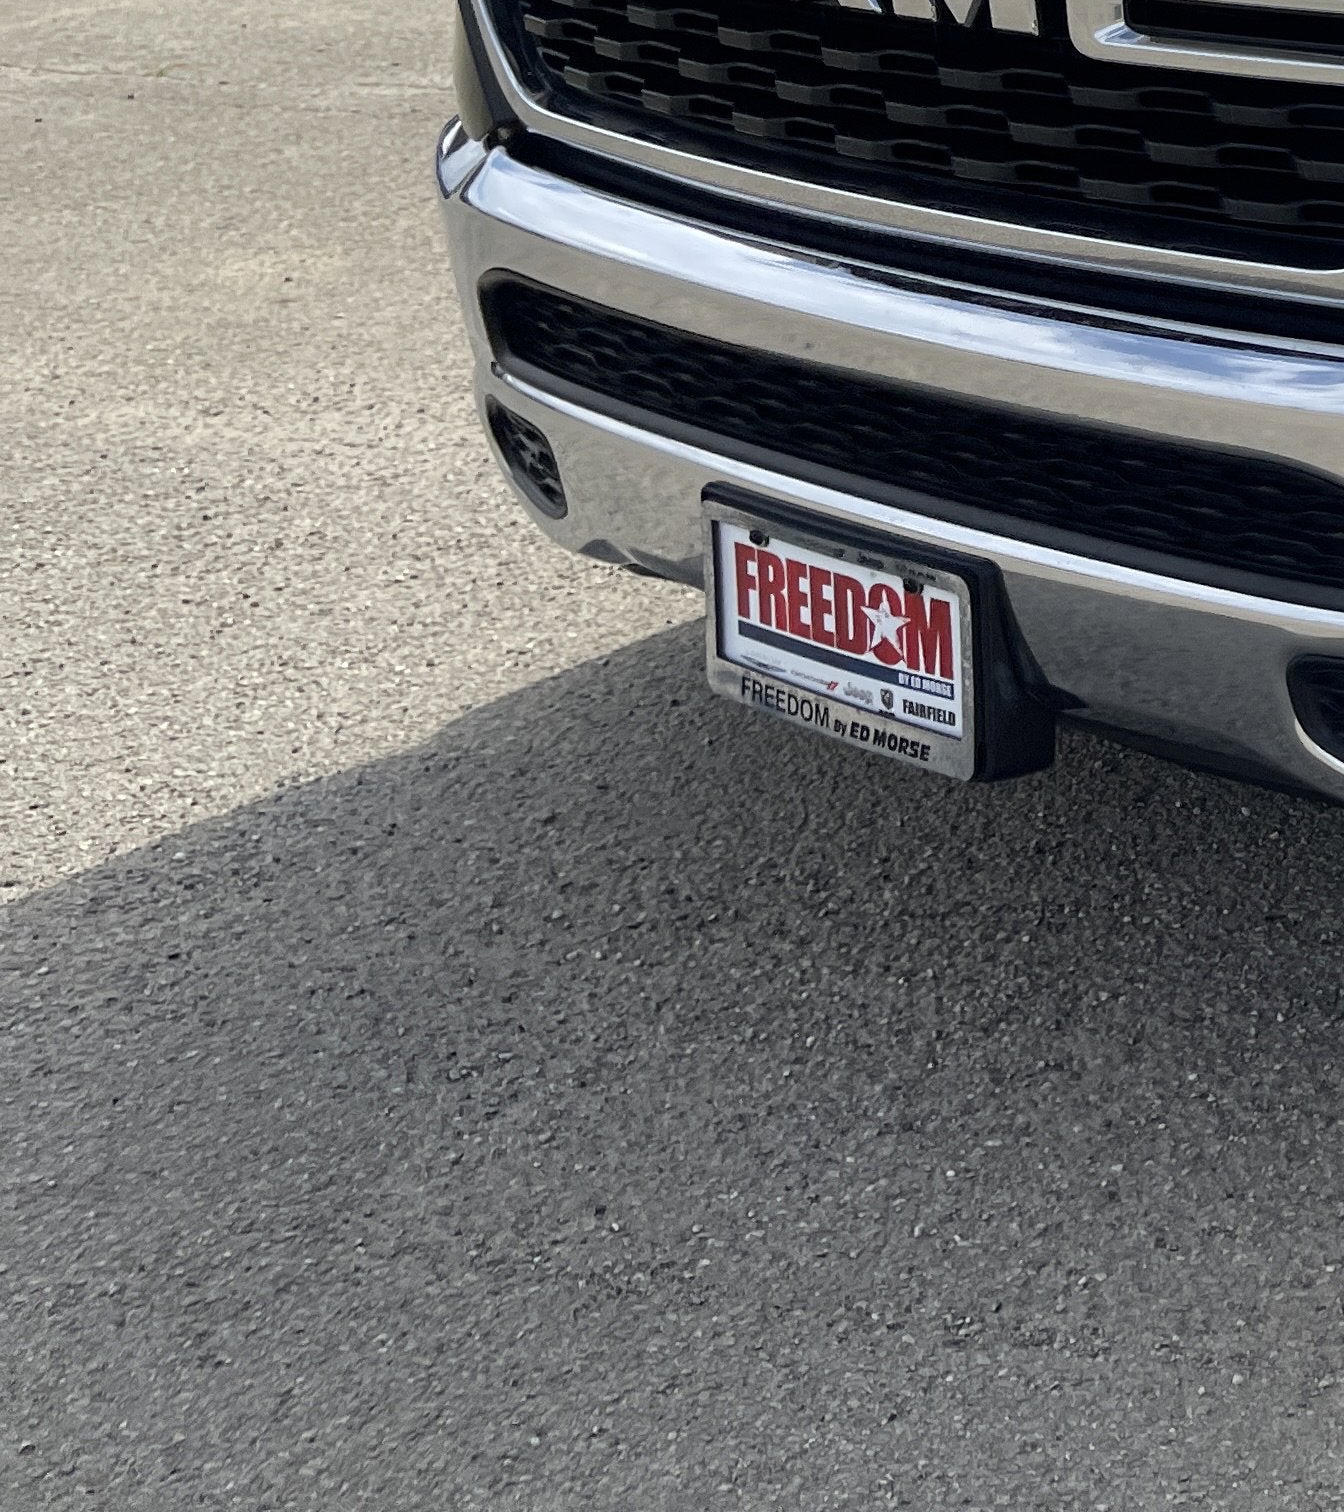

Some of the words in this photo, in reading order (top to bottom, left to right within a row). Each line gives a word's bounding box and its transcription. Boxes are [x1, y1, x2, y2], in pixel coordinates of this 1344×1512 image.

[734, 541, 955, 680] FREEDOM
[741, 675, 830, 729] FREEDOM
[850, 720, 870, 742] ED
[873, 727, 931, 762] MORSE
[902, 698, 956, 727] FAIRFIELD
